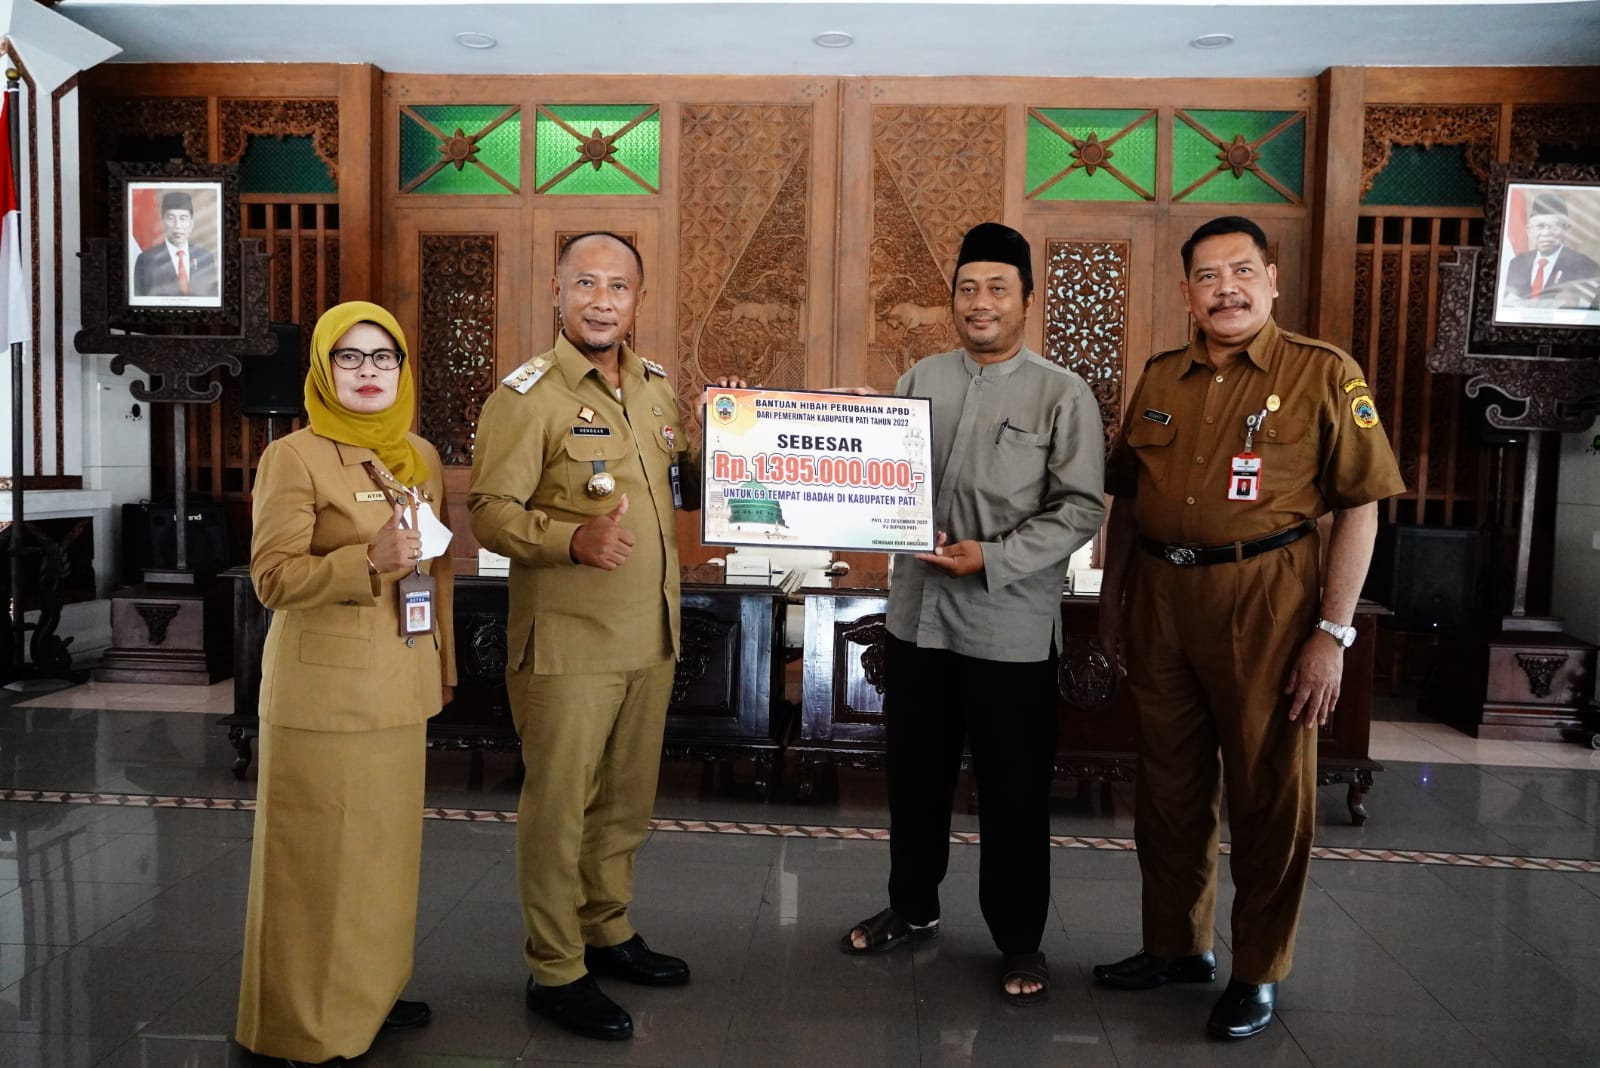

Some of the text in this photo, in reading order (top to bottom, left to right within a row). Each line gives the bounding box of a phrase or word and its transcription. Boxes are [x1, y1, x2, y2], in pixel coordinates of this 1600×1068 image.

[755, 399, 910, 416] BANTUAN HIBAH PERUBAHAN APBD
[756, 410, 909, 427] DARI PEMERINTAH KABUPATEN PATI TAHUN 2022
[777, 433, 862, 453] SEBESAR
[714, 450, 925, 493] Rp. 1.395.000.000,-
[723, 487, 916, 507] UNTUK 69 TEMPAT IBADAH DI KABUPATEN PATI
